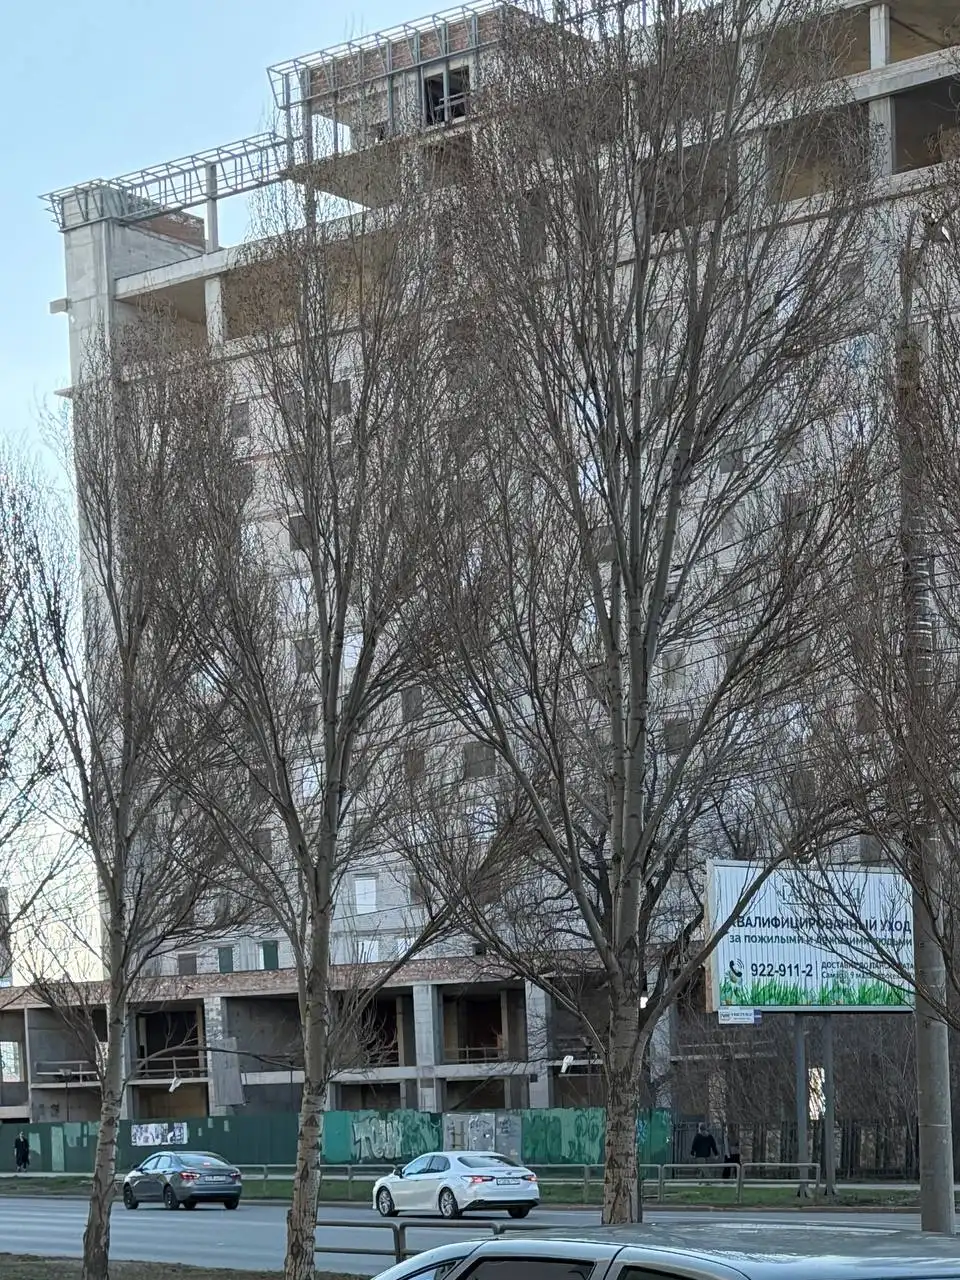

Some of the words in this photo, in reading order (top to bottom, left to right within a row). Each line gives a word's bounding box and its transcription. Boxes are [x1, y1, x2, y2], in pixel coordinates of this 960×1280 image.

[880, 919, 912, 933] УХОД
[730, 935, 741, 943] за
[744, 935, 803, 944] пожилыми
[751, 963, 813, 977] 922-911-2
